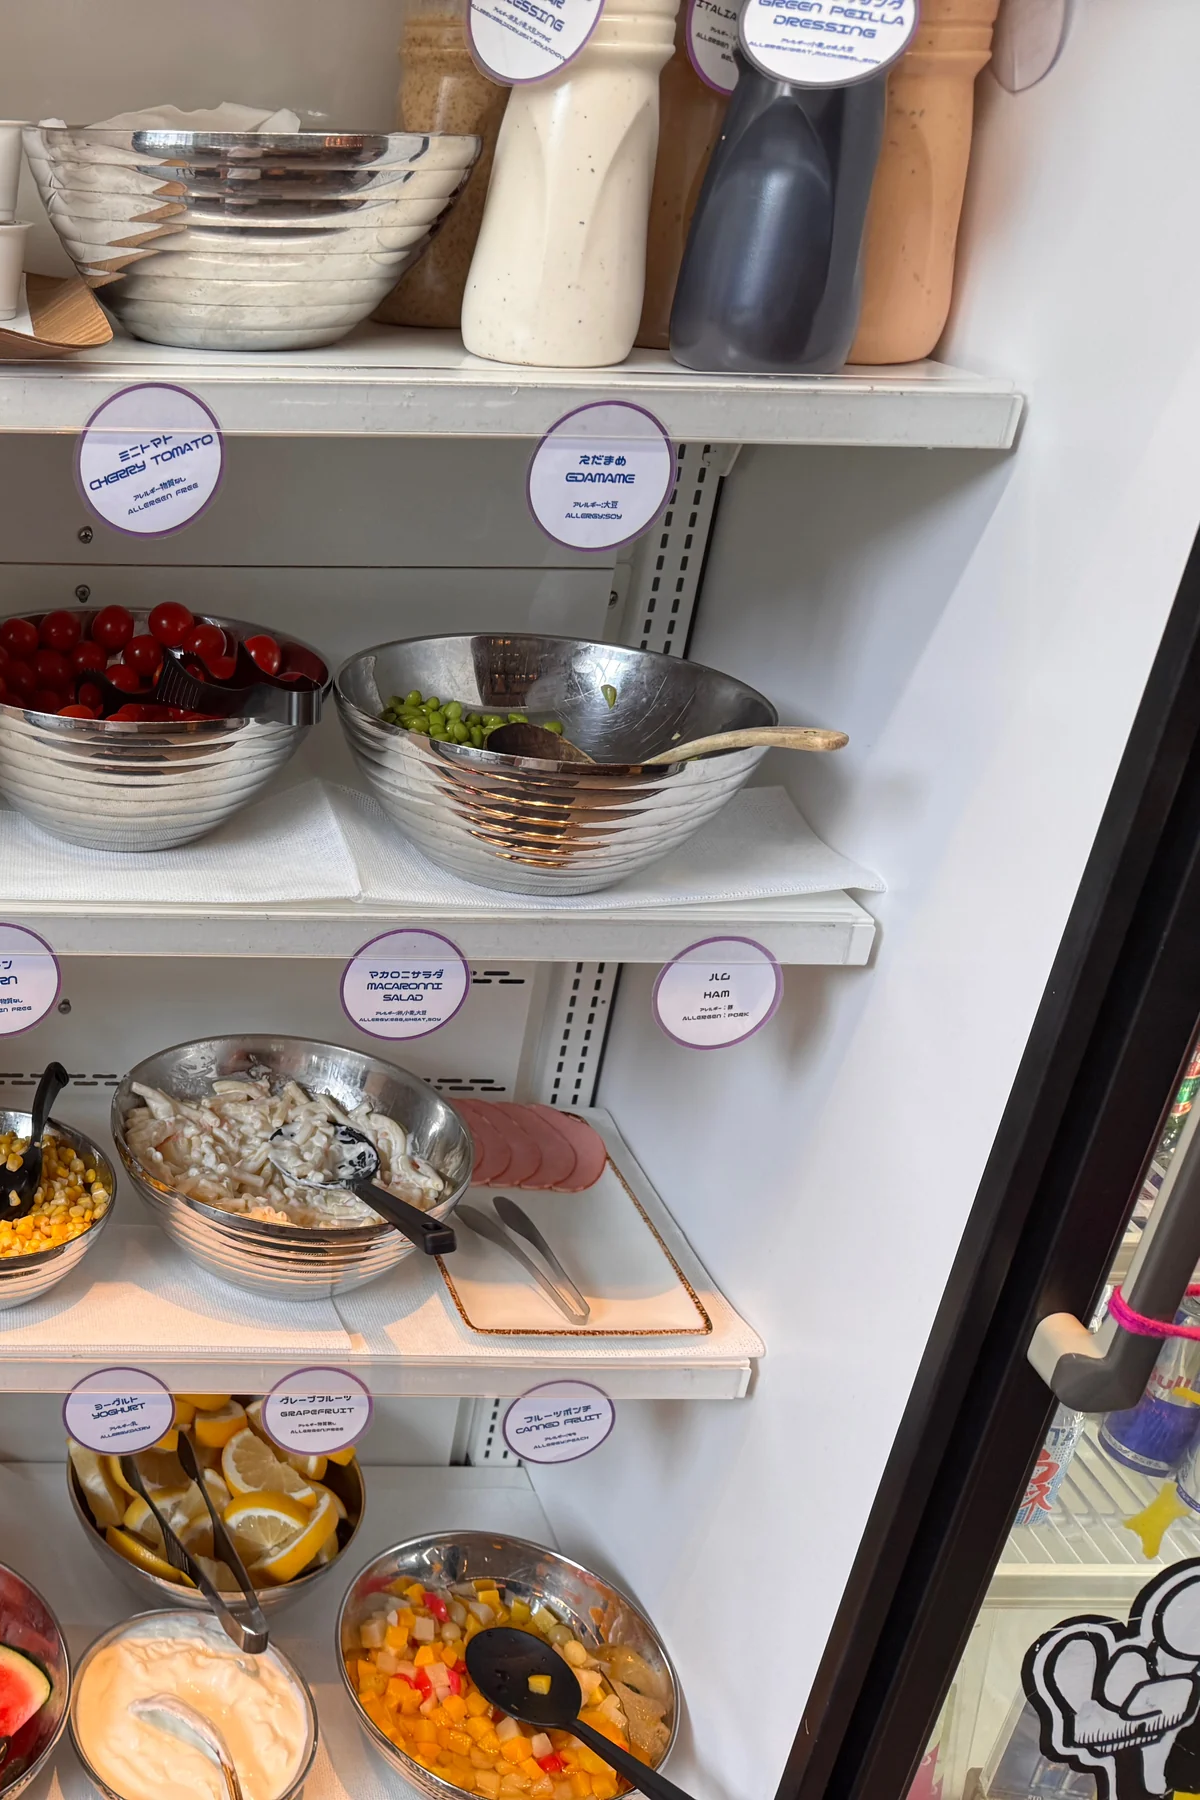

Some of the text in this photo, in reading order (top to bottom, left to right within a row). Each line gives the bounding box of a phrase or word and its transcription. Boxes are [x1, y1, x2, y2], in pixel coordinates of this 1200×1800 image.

[758, 0, 823, 13] GREEN
[829, 5, 904, 26] PEILLA
[773, 14, 877, 39] DRESSING
[118, 435, 173, 462] ミニトマト
[89, 434, 214, 491] CHERRY TOMATO
[579, 455, 627, 467] えだまめ
[565, 472, 635, 484] EDAMAME
[127, 482, 199, 515] ALLERGEN FREE
[565, 512, 622, 520] ALLERGY:SOY
[369, 968, 444, 979] マカロニサラダ
[709, 972, 731, 982] ハム
[366, 982, 443, 990] MACARONNI
[382, 994, 424, 1002] SALAD
[703, 989, 730, 999] HAM
[682, 1013, 722, 1021] ALLERGEN
[94, 1396, 139, 1411] ヨーグルト
[279, 1395, 352, 1405] グレープフルーツ
[91, 1402, 146, 1420] YOGHURT
[280, 1407, 355, 1418] GRAPEFRUIT
[524, 1404, 592, 1424] フルーツポンチ
[515, 1412, 602, 1435] CANNED FRUIT
